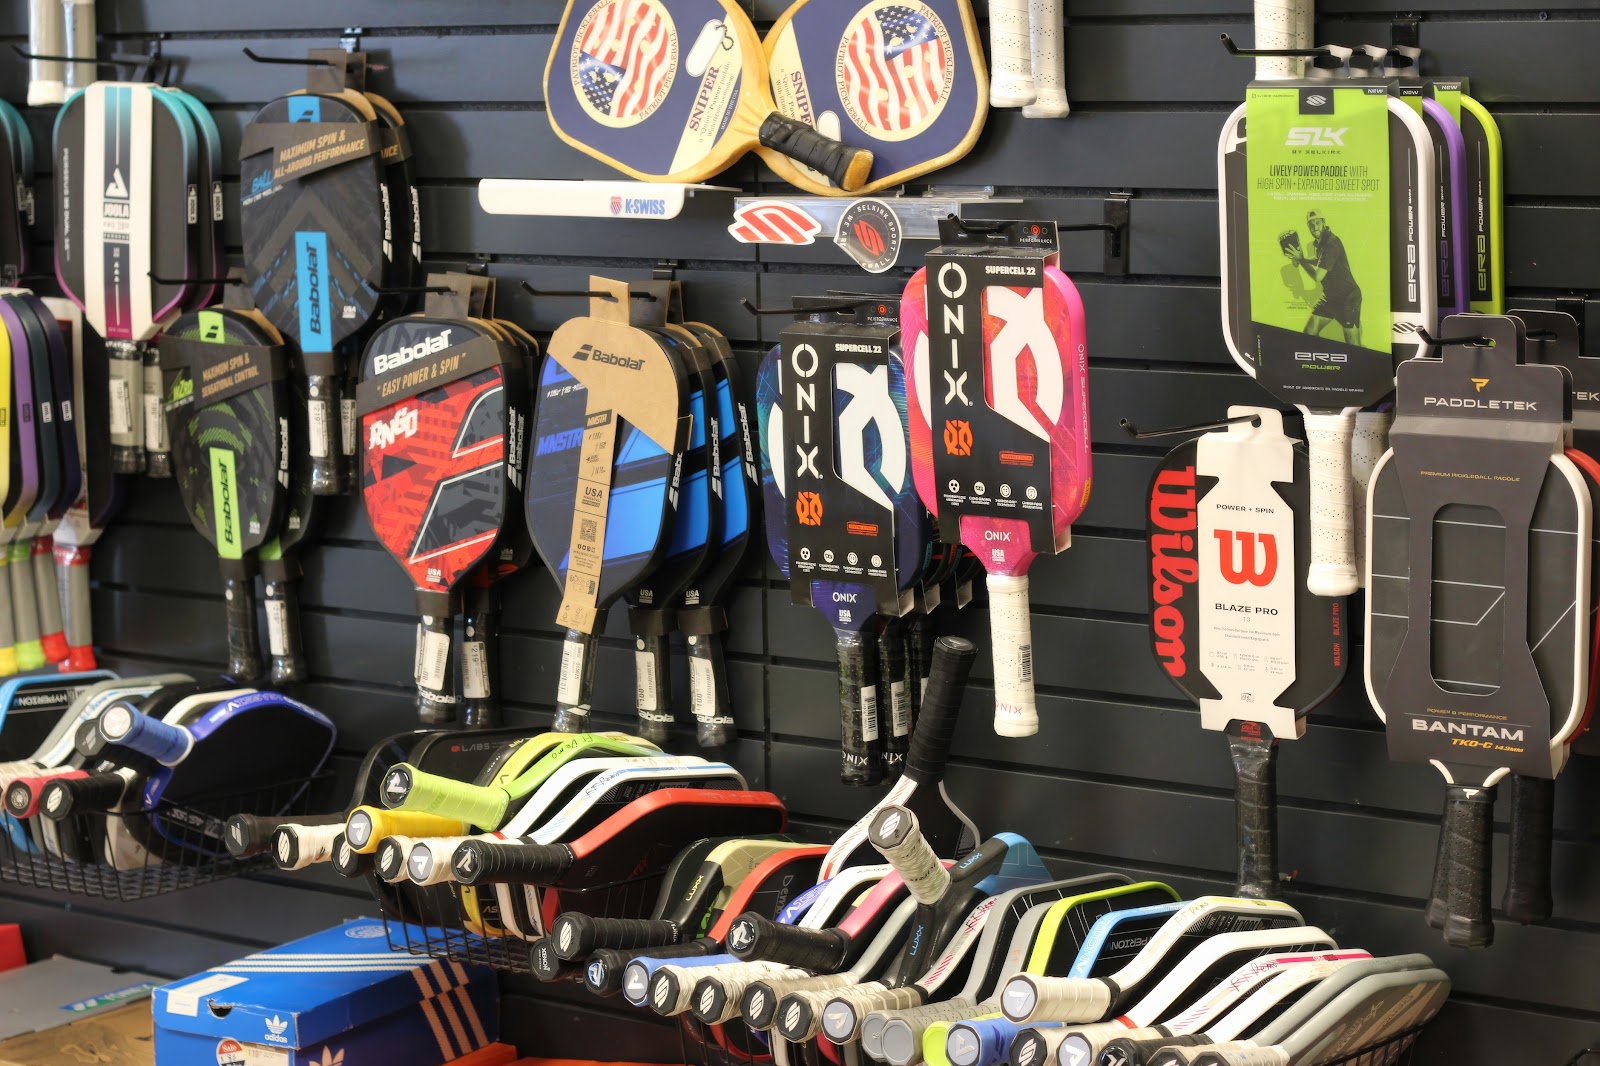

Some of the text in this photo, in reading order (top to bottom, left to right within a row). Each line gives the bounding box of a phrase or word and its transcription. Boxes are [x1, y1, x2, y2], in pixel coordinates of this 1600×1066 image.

[919, 5, 947, 39] PATRIOT
[571, 44, 580, 86] PATRIOT
[837, 36, 849, 79] PATRIOT
[639, 88, 665, 120] PATRIOT
[689, 66, 720, 132] SNIPER
[791, 71, 812, 126] SNIPE
[1284, 127, 1350, 146] SLK
[280, 130, 346, 163] MAXIMUM SPIN &
[274, 154, 312, 180] ALL-AROUND
[312, 138, 366, 165] PERFORMANCE
[1270, 165, 1368, 177] LIVELY POWER PADDLE WITH
[1257, 178, 1274, 190] HIGH
[1276, 178, 1292, 190] SPIN
[1298, 178, 1334, 191] EXPANDED
[1336, 178, 1359, 191] SWEET
[1361, 178, 1380, 191] SPOT
[104, 204, 130, 217] JOOLA
[857, 204, 888, 220] SELKIRK
[986, 266, 1036, 276] SUPERCELL 22
[306, 242, 321, 334] Babolat
[938, 262, 968, 406] ONIX
[374, 329, 452, 376] Babolat
[835, 344, 882, 354] SUPERCELL 22
[1078, 344, 1086, 372] ONIX
[203, 352, 250, 382] MAXIMUM SPIN &
[592, 350, 646, 371] Babolat
[202, 365, 259, 398] SENSATIONAL CONTROL
[382, 356, 460, 398] EASY POWER & SPIN
[792, 344, 819, 478] ONIX
[1424, 396, 1537, 410] PADDLETEK
[218, 458, 234, 545] Babolat
[585, 486, 602, 498] USA
[1216, 504, 1246, 512] POWER
[985, 530, 1010, 542] ONIX
[992, 548, 1004, 556] USA
[1214, 528, 1278, 587] W
[428, 568, 442, 576] USA
[1150, 466, 1199, 678] Wilson
[640, 589, 654, 598] USA
[832, 592, 857, 603] ONIX
[839, 610, 852, 618] USA
[1215, 603, 1278, 616] BLAZE PRO
[420, 688, 456, 704] abola
[639, 709, 674, 722] abola
[697, 714, 734, 724] abola
[1458, 711, 1508, 720] PERFORMANCE
[1412, 718, 1524, 742] BANTAM
[1452, 738, 1493, 749] TKO-C
[882, 752, 903, 764] NIX
[959, 852, 982, 869] LUXX
[686, 875, 704, 901] LUXX
[910, 924, 924, 956] LUXX
[542, 948, 550, 972] XENON
[264, 1034, 288, 1043] adidas
